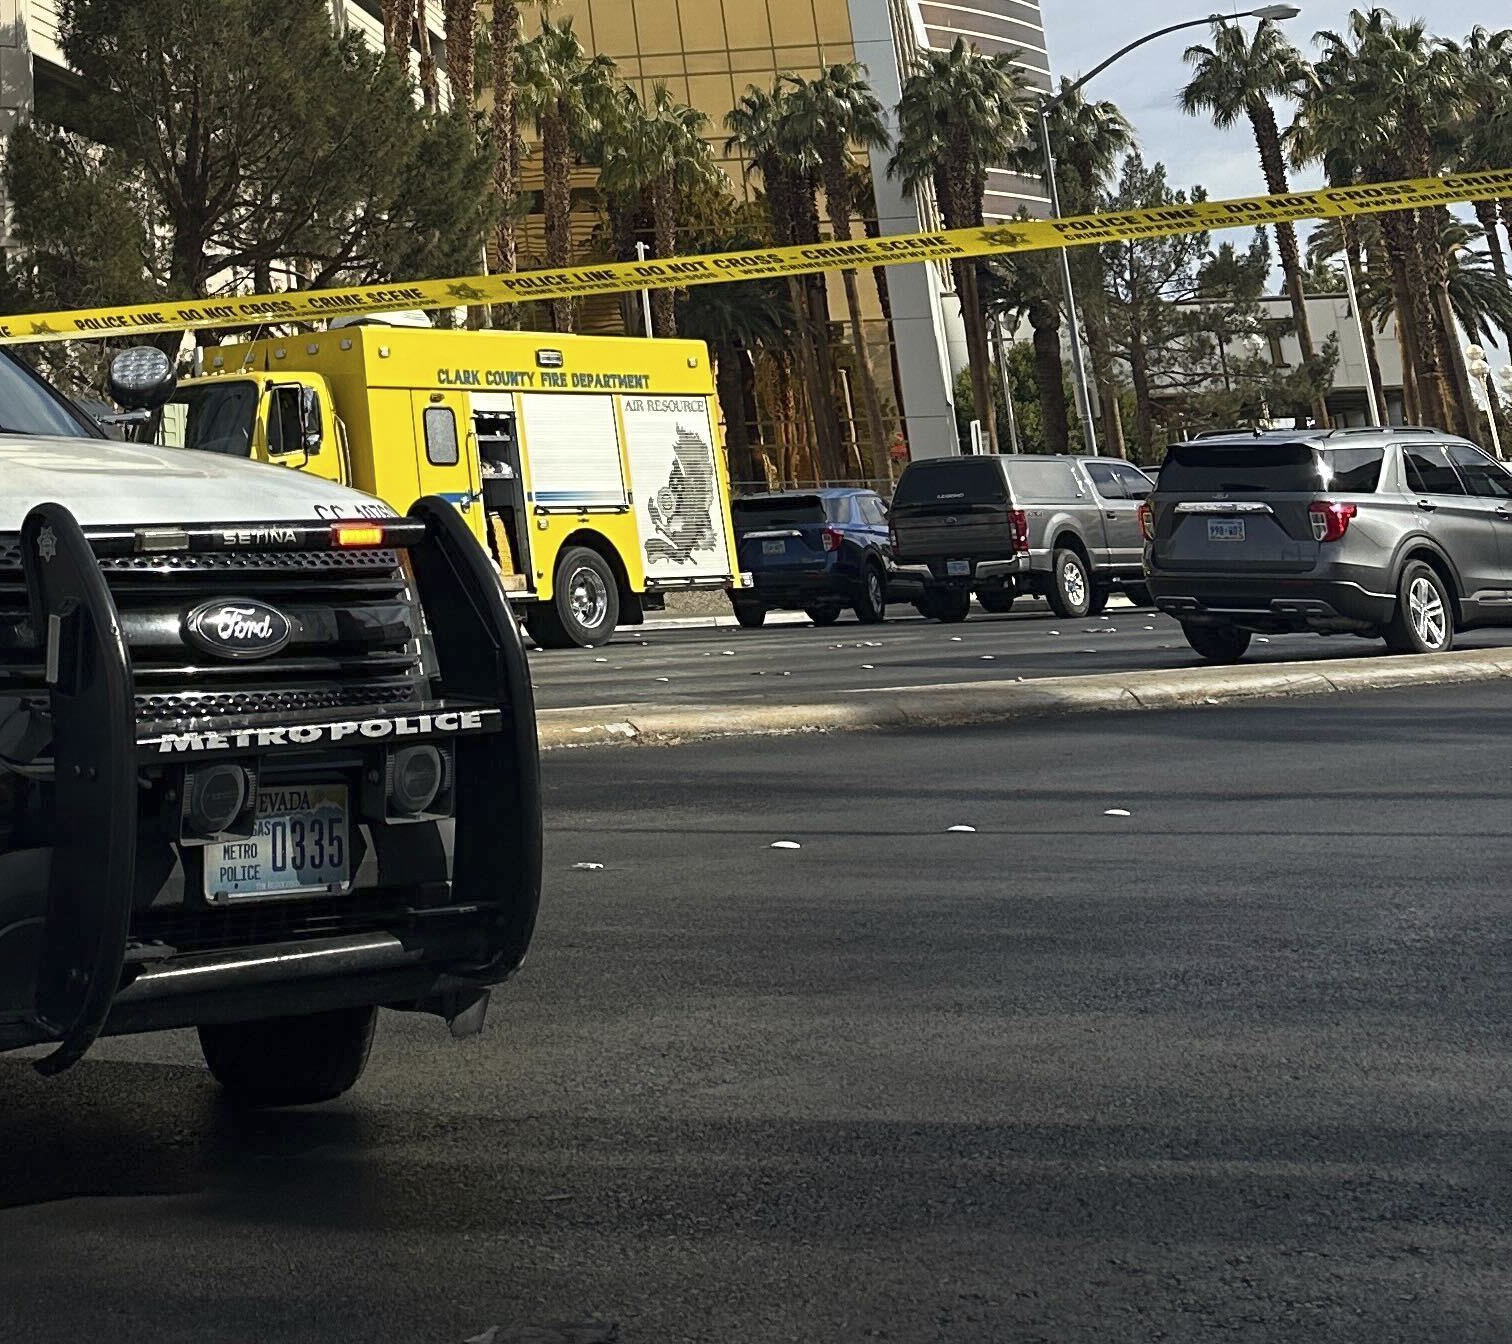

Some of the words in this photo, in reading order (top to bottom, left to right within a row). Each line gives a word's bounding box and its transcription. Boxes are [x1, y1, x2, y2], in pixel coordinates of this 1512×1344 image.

[1052, 215, 1139, 233] POLICE
[1142, 208, 1202, 223] LINE
[1222, 201, 1263, 214] DO
[1263, 195, 1322, 211] NOT
[1326, 184, 1418, 202] CROSS
[502, 273, 575, 290] POLICE
[573, 269, 622, 284] LINE
[633, 264, 667, 277] DO
[666, 260, 711, 274] NOT
[712, 252, 785, 270] CROSS
[800, 243, 878, 261] CRIME
[876, 235, 954, 252] SCENE
[74, 315, 131, 331] POLICE
[132, 312, 165, 326] LINE
[177, 308, 205, 321] DO
[205, 305, 237, 319] NOT
[239, 300, 297, 316] CROSS
[308, 293, 367, 310] CRIME
[366, 287, 428, 305] SCENE
[437, 368, 480, 386] CLARK
[485, 370, 535, 387] COUNTY
[540, 372, 567, 388] FIRE
[571, 373, 650, 390] DEPARTMENT
[625, 399, 646, 412] AIR
[647, 399, 705, 413] RESOURCE
[223, 528, 297, 546] SETINA
[217, 606, 273, 640] Ford
[258, 791, 312, 813] EVADA
[223, 843, 258, 861] METRO
[271, 817, 344, 873] 0335
[220, 864, 261, 883] POLICE
